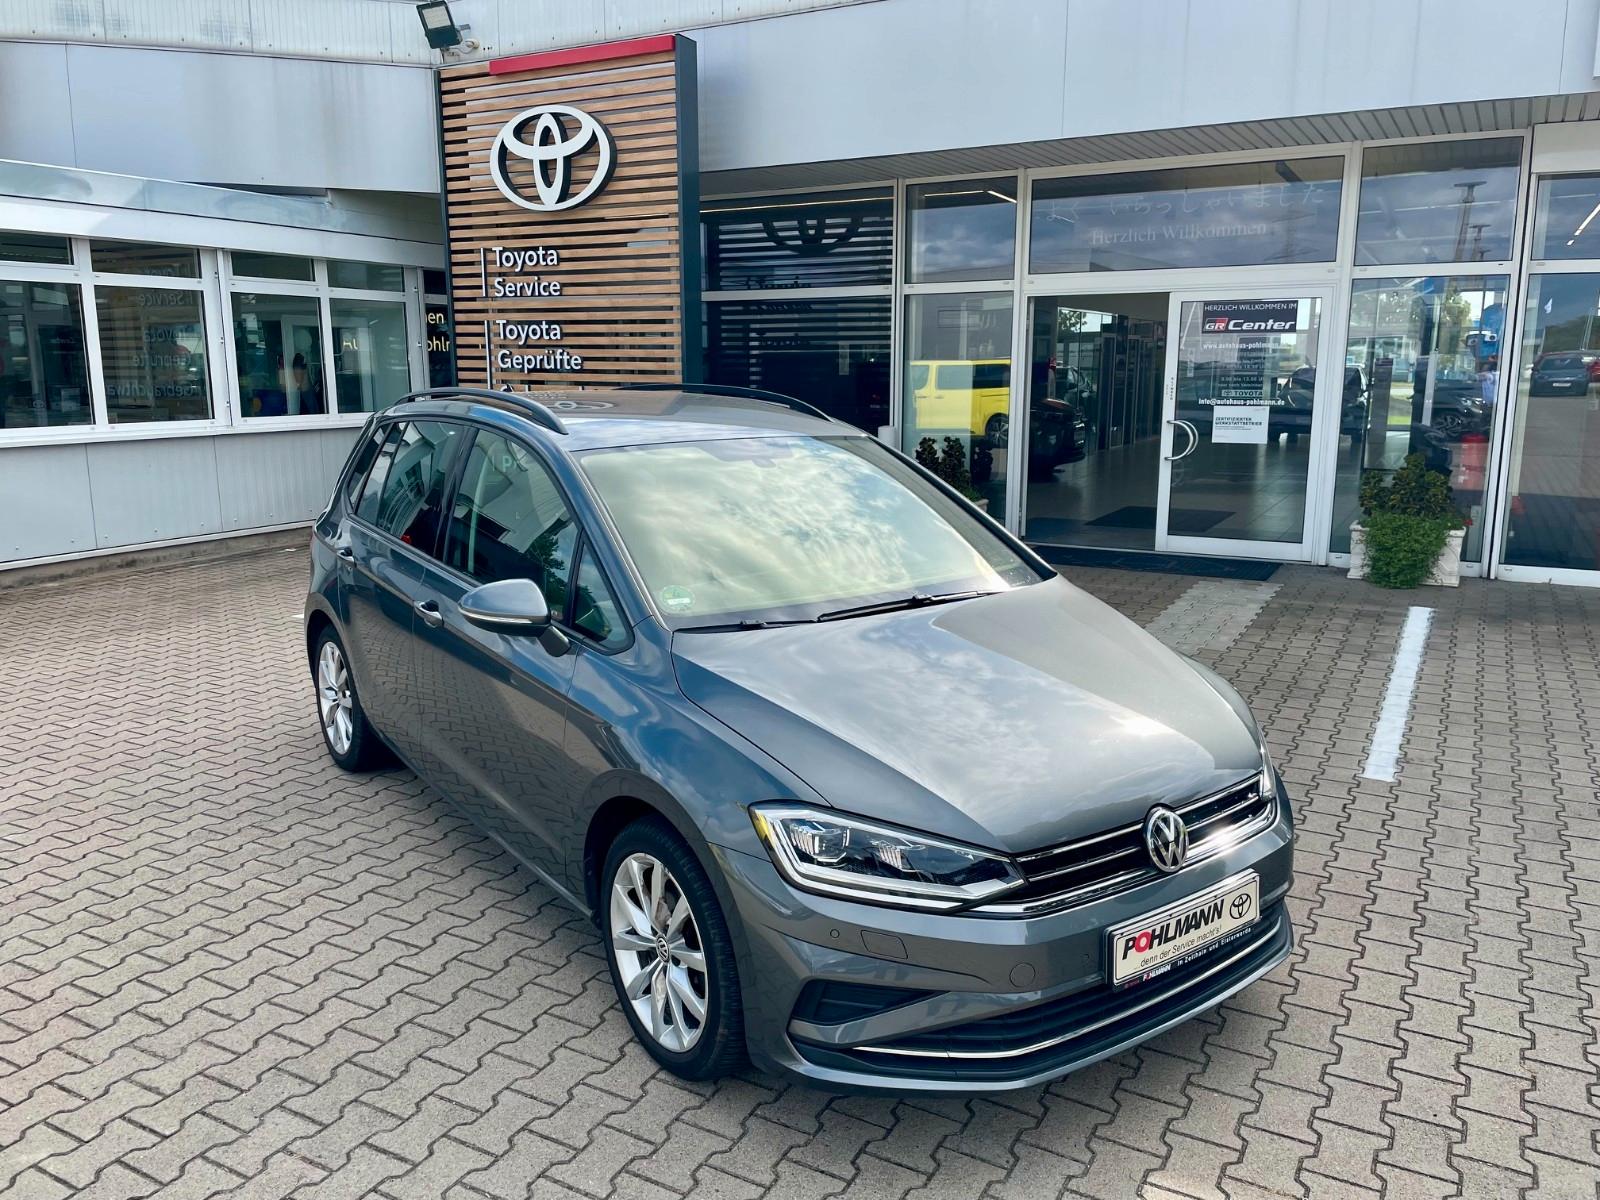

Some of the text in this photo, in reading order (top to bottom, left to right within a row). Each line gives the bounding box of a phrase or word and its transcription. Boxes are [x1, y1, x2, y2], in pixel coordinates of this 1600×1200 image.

[1090, 221, 1267, 246] Herzlich Willkommen
[491, 246, 559, 272] Toyota
[493, 276, 562, 297] Service
[426, 312, 444, 324] en
[1204, 302, 1297, 312] HERZLICH WILLKOMMEN IM
[495, 319, 562, 346] Toyota
[1205, 319, 1296, 331] GR Center
[497, 350, 583, 374] Geprüfte
[1122, 899, 1225, 960] POHLMANN
[1159, 948, 1171, 960] der
[1172, 939, 1195, 954] Service
